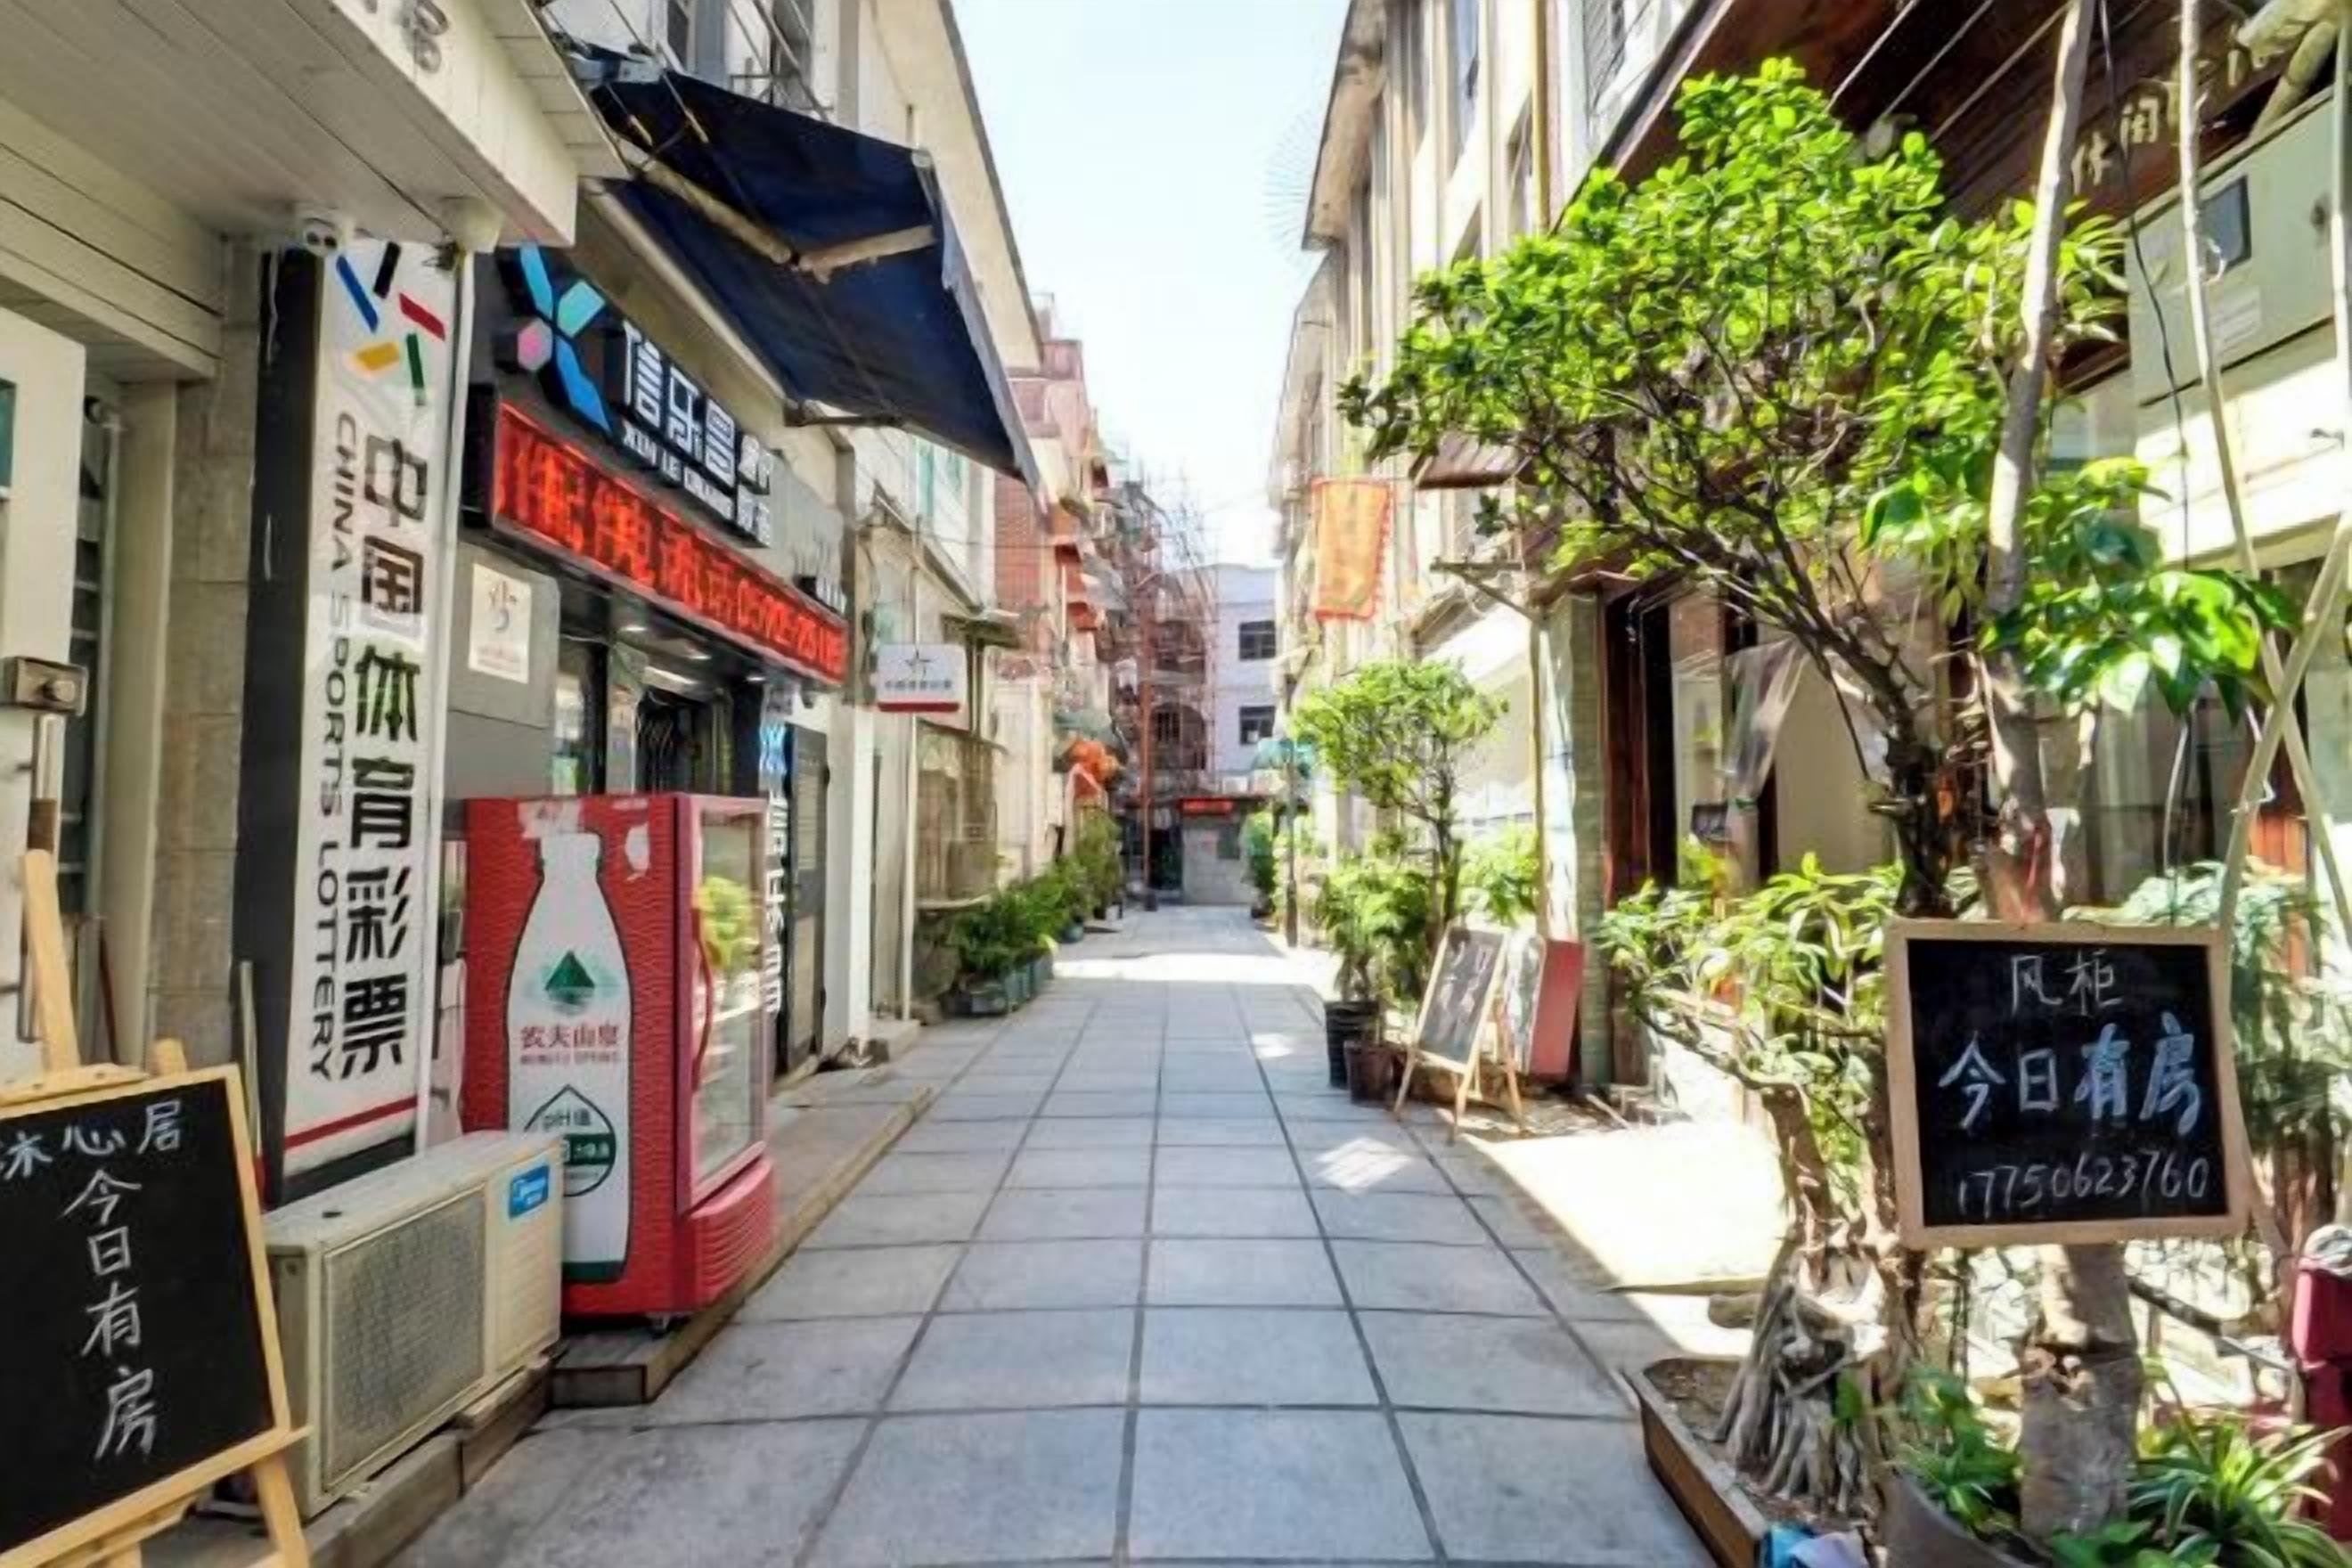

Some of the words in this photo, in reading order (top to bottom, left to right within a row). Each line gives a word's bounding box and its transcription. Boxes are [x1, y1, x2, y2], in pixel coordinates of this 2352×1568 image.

[331, 412, 356, 571] CHINA
[339, 432, 428, 1080] 中国体育彩票
[308, 840, 339, 1082] LOTTERY
[1938, 1010, 2202, 1138] 今日有房
[1958, 1150, 2209, 1221] 17750623760
[57, 1167, 159, 1462] 今日有房
